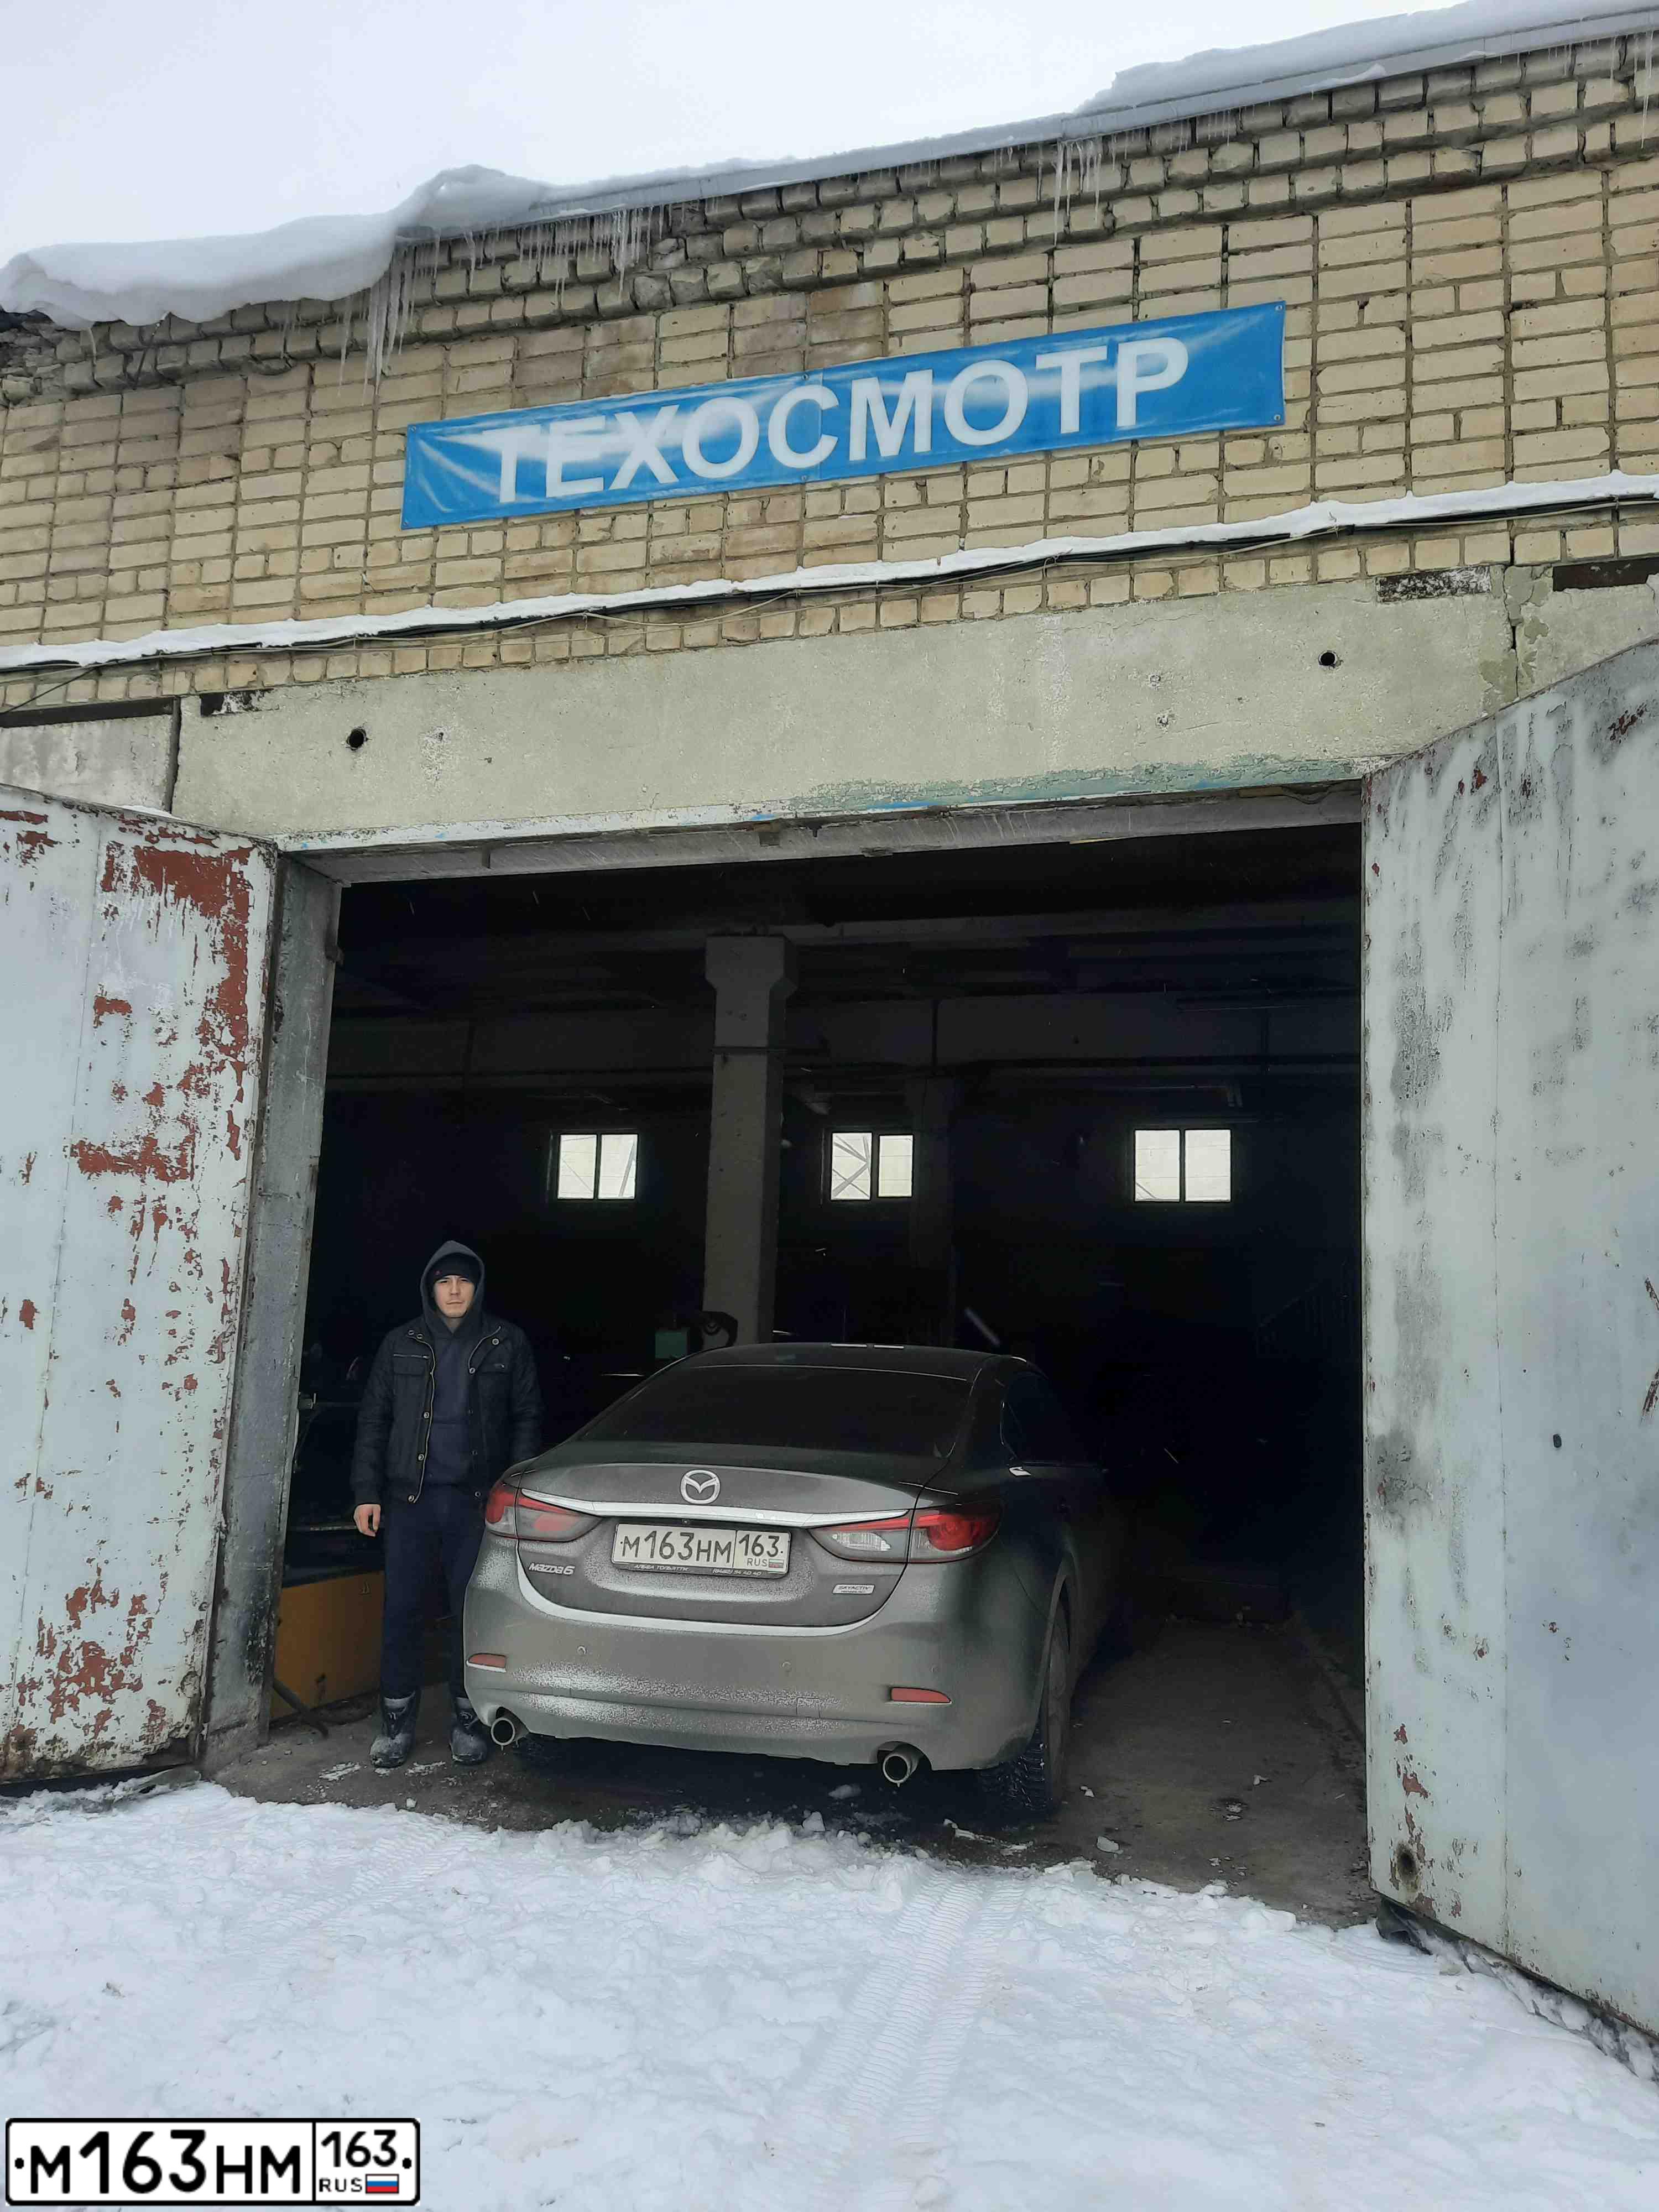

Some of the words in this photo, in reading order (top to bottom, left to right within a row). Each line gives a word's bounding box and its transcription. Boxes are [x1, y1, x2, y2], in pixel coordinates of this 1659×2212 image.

[482, 336, 1189, 504] ТЕХОСМОТР
[622, 1530, 732, 1563] М163НМ
[738, 1534, 780, 1557] 163
[747, 1558, 768, 1567] RUS
